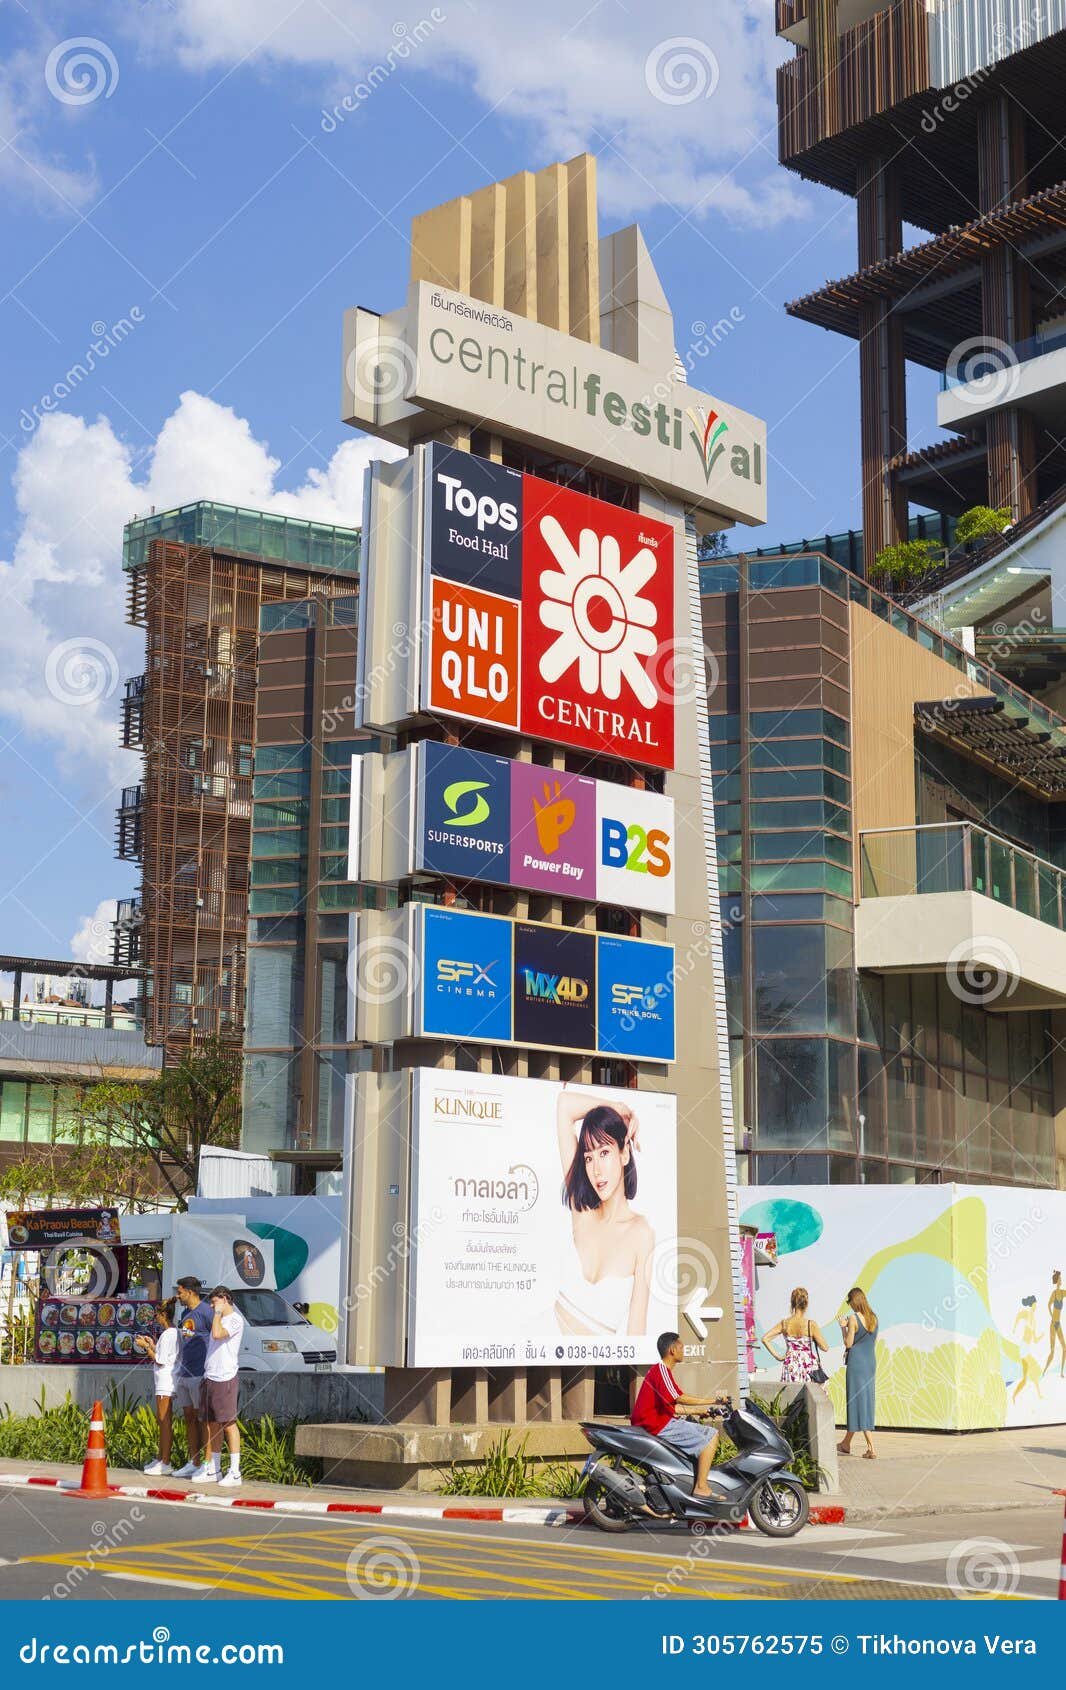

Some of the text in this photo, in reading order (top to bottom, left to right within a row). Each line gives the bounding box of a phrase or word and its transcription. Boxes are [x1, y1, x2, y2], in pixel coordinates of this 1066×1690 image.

[437, 473, 518, 531] Tops
[448, 528, 508, 560] Food Hall
[442, 600, 503, 655] UNI
[441, 650, 509, 702] QLO
[538, 695, 658, 746] CENTRAL
[428, 830, 504, 855] SUPERSPORTS
[602, 817, 672, 878] B2S
[523, 855, 585, 881] Power Buy
[437, 984, 496, 998] CINEMA
[525, 969, 589, 1005] MX4D
[611, 1007, 662, 1020] STRIKE BOWL
[434, 1097, 503, 1119] KLINIQUE
[487, 1262, 502, 1271] THE
[503, 1263, 537, 1273] KLINIQUE
[516, 1280, 525, 1290] 15
[540, 1345, 546, 1359] 4
[567, 1345, 635, 1359] 038-043-553
[684, 1344, 706, 1357] EXIT
